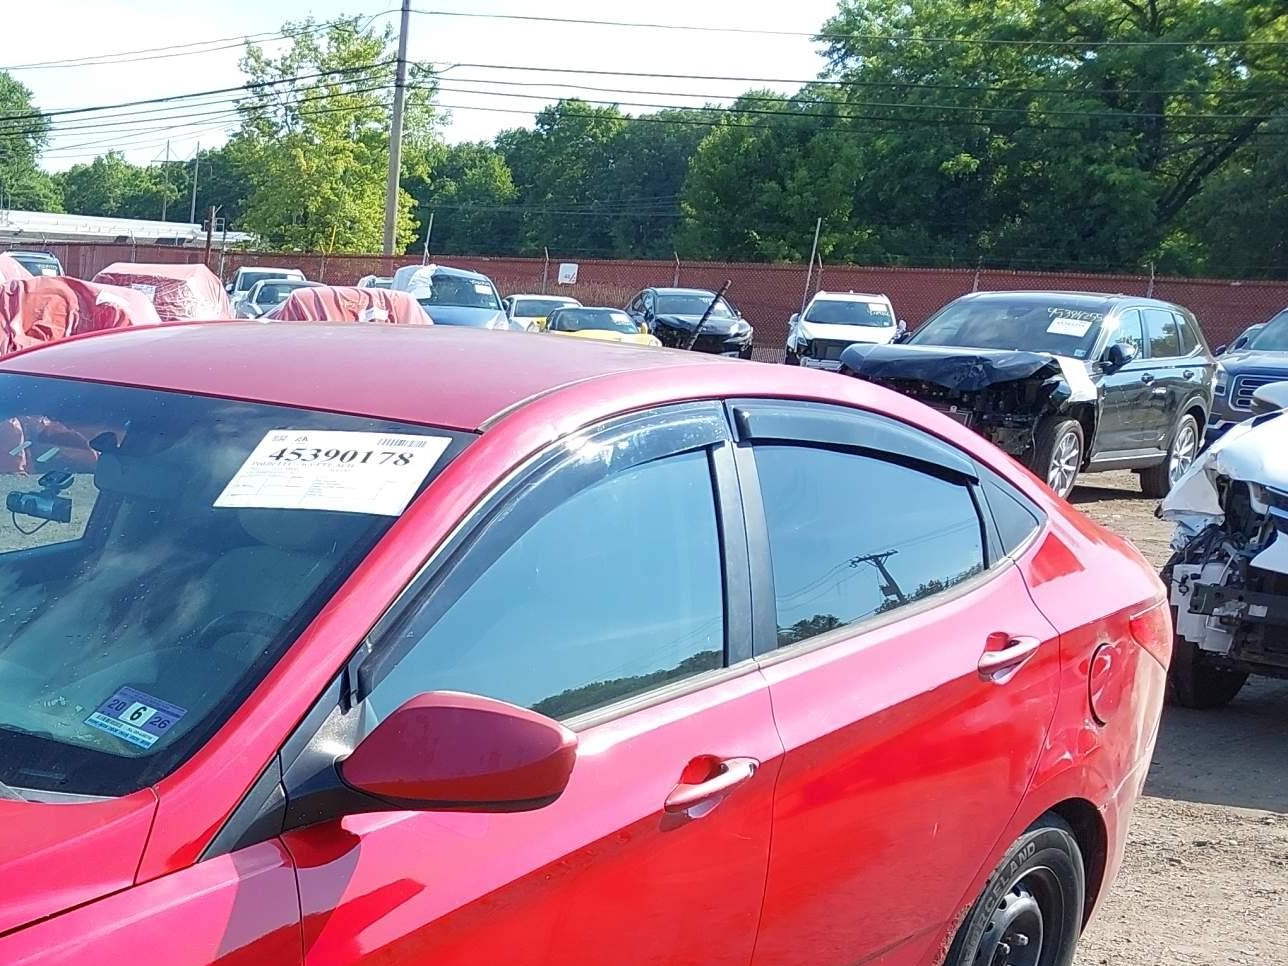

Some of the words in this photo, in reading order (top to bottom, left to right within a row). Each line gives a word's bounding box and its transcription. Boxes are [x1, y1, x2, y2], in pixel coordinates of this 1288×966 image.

[268, 447, 415, 467] 45390178
[107, 698, 127, 712] 20
[130, 706, 147, 721] 6
[149, 715, 171, 729] 26
